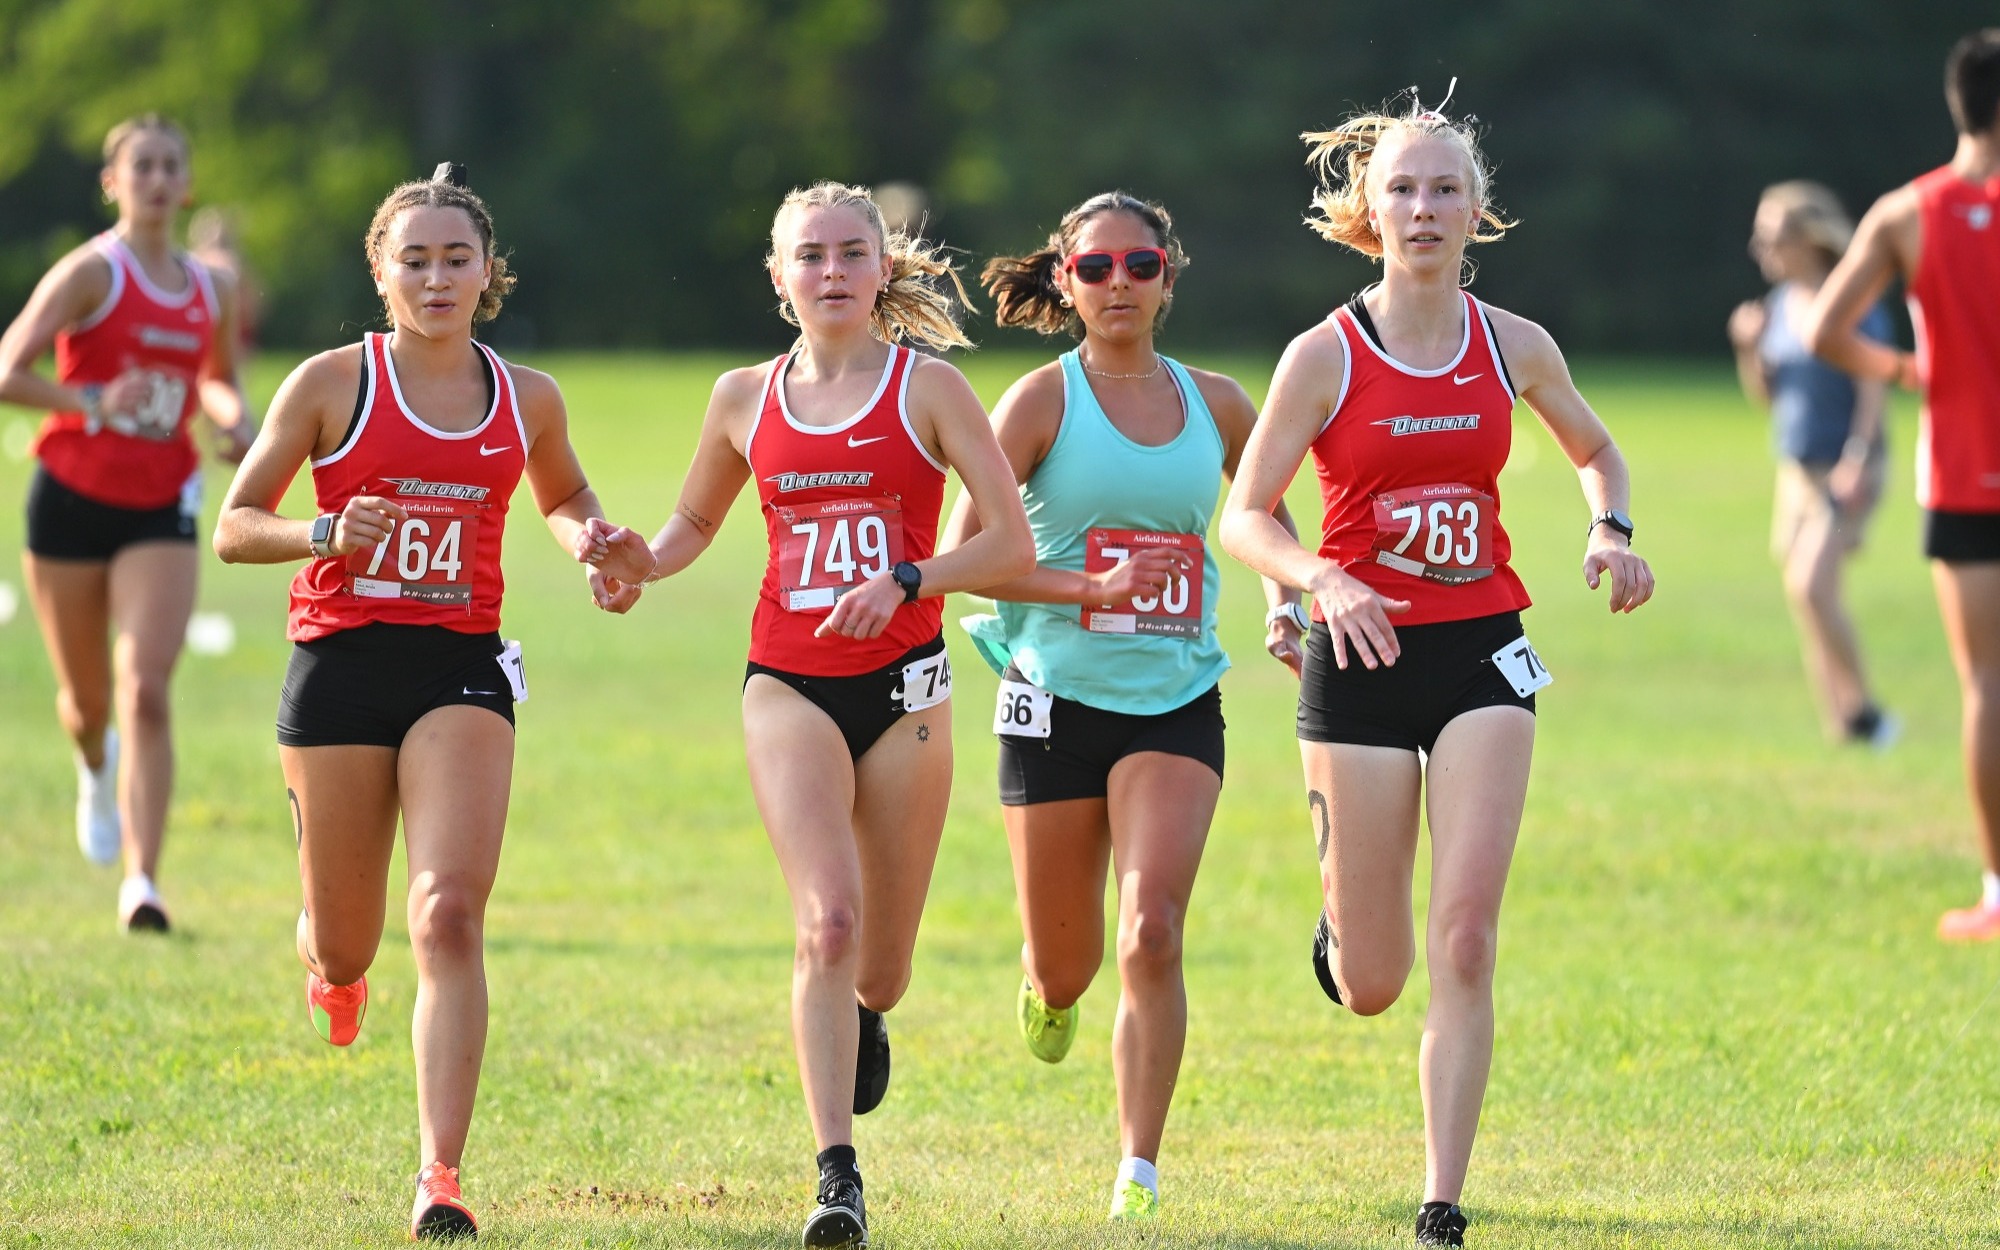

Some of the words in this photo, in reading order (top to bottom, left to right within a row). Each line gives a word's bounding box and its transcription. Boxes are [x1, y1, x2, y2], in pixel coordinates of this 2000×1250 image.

[1391, 415, 1480, 436] ONEONTA
[397, 478, 490, 501] ONEONTA
[778, 472, 873, 492] ONEONTA
[1422, 487, 1450, 496] Airfield
[1452, 486, 1472, 494] Invite
[401, 503, 431, 513] Airfield
[432, 504, 454, 513] Invite
[820, 504, 849, 513] Airfield
[850, 502, 873, 511] Invite
[1133, 534, 1160, 543] Airfield
[1161, 536, 1181, 545] Invite
[1391, 500, 1479, 565] 763
[366, 517, 462, 581] 764
[791, 516, 889, 586] 749
